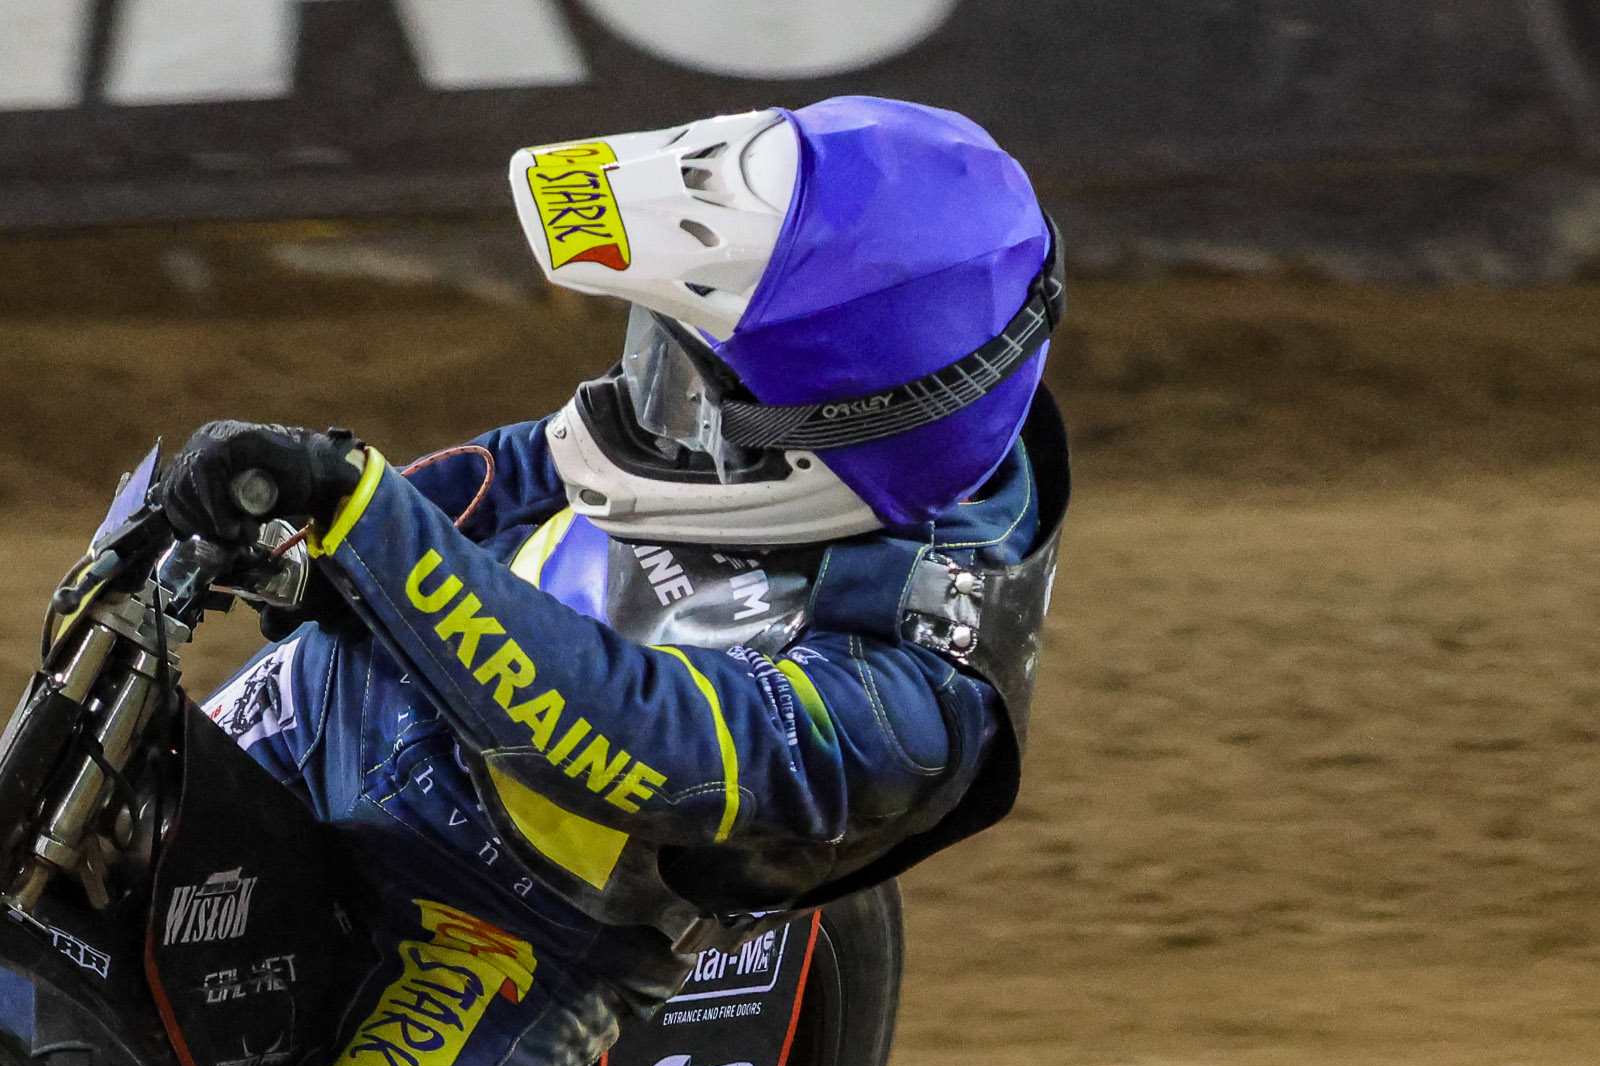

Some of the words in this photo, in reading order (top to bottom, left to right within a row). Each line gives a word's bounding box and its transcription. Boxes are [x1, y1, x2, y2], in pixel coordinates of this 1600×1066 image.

[822, 393, 894, 419] OAKLEY
[405, 548, 667, 814] UKRAINE
[663, 1010, 702, 1027] ENTRANCE
[702, 1007, 719, 1022] AND
[719, 1004, 736, 1019] FIRE
[736, 1002, 762, 1018] DOORS
